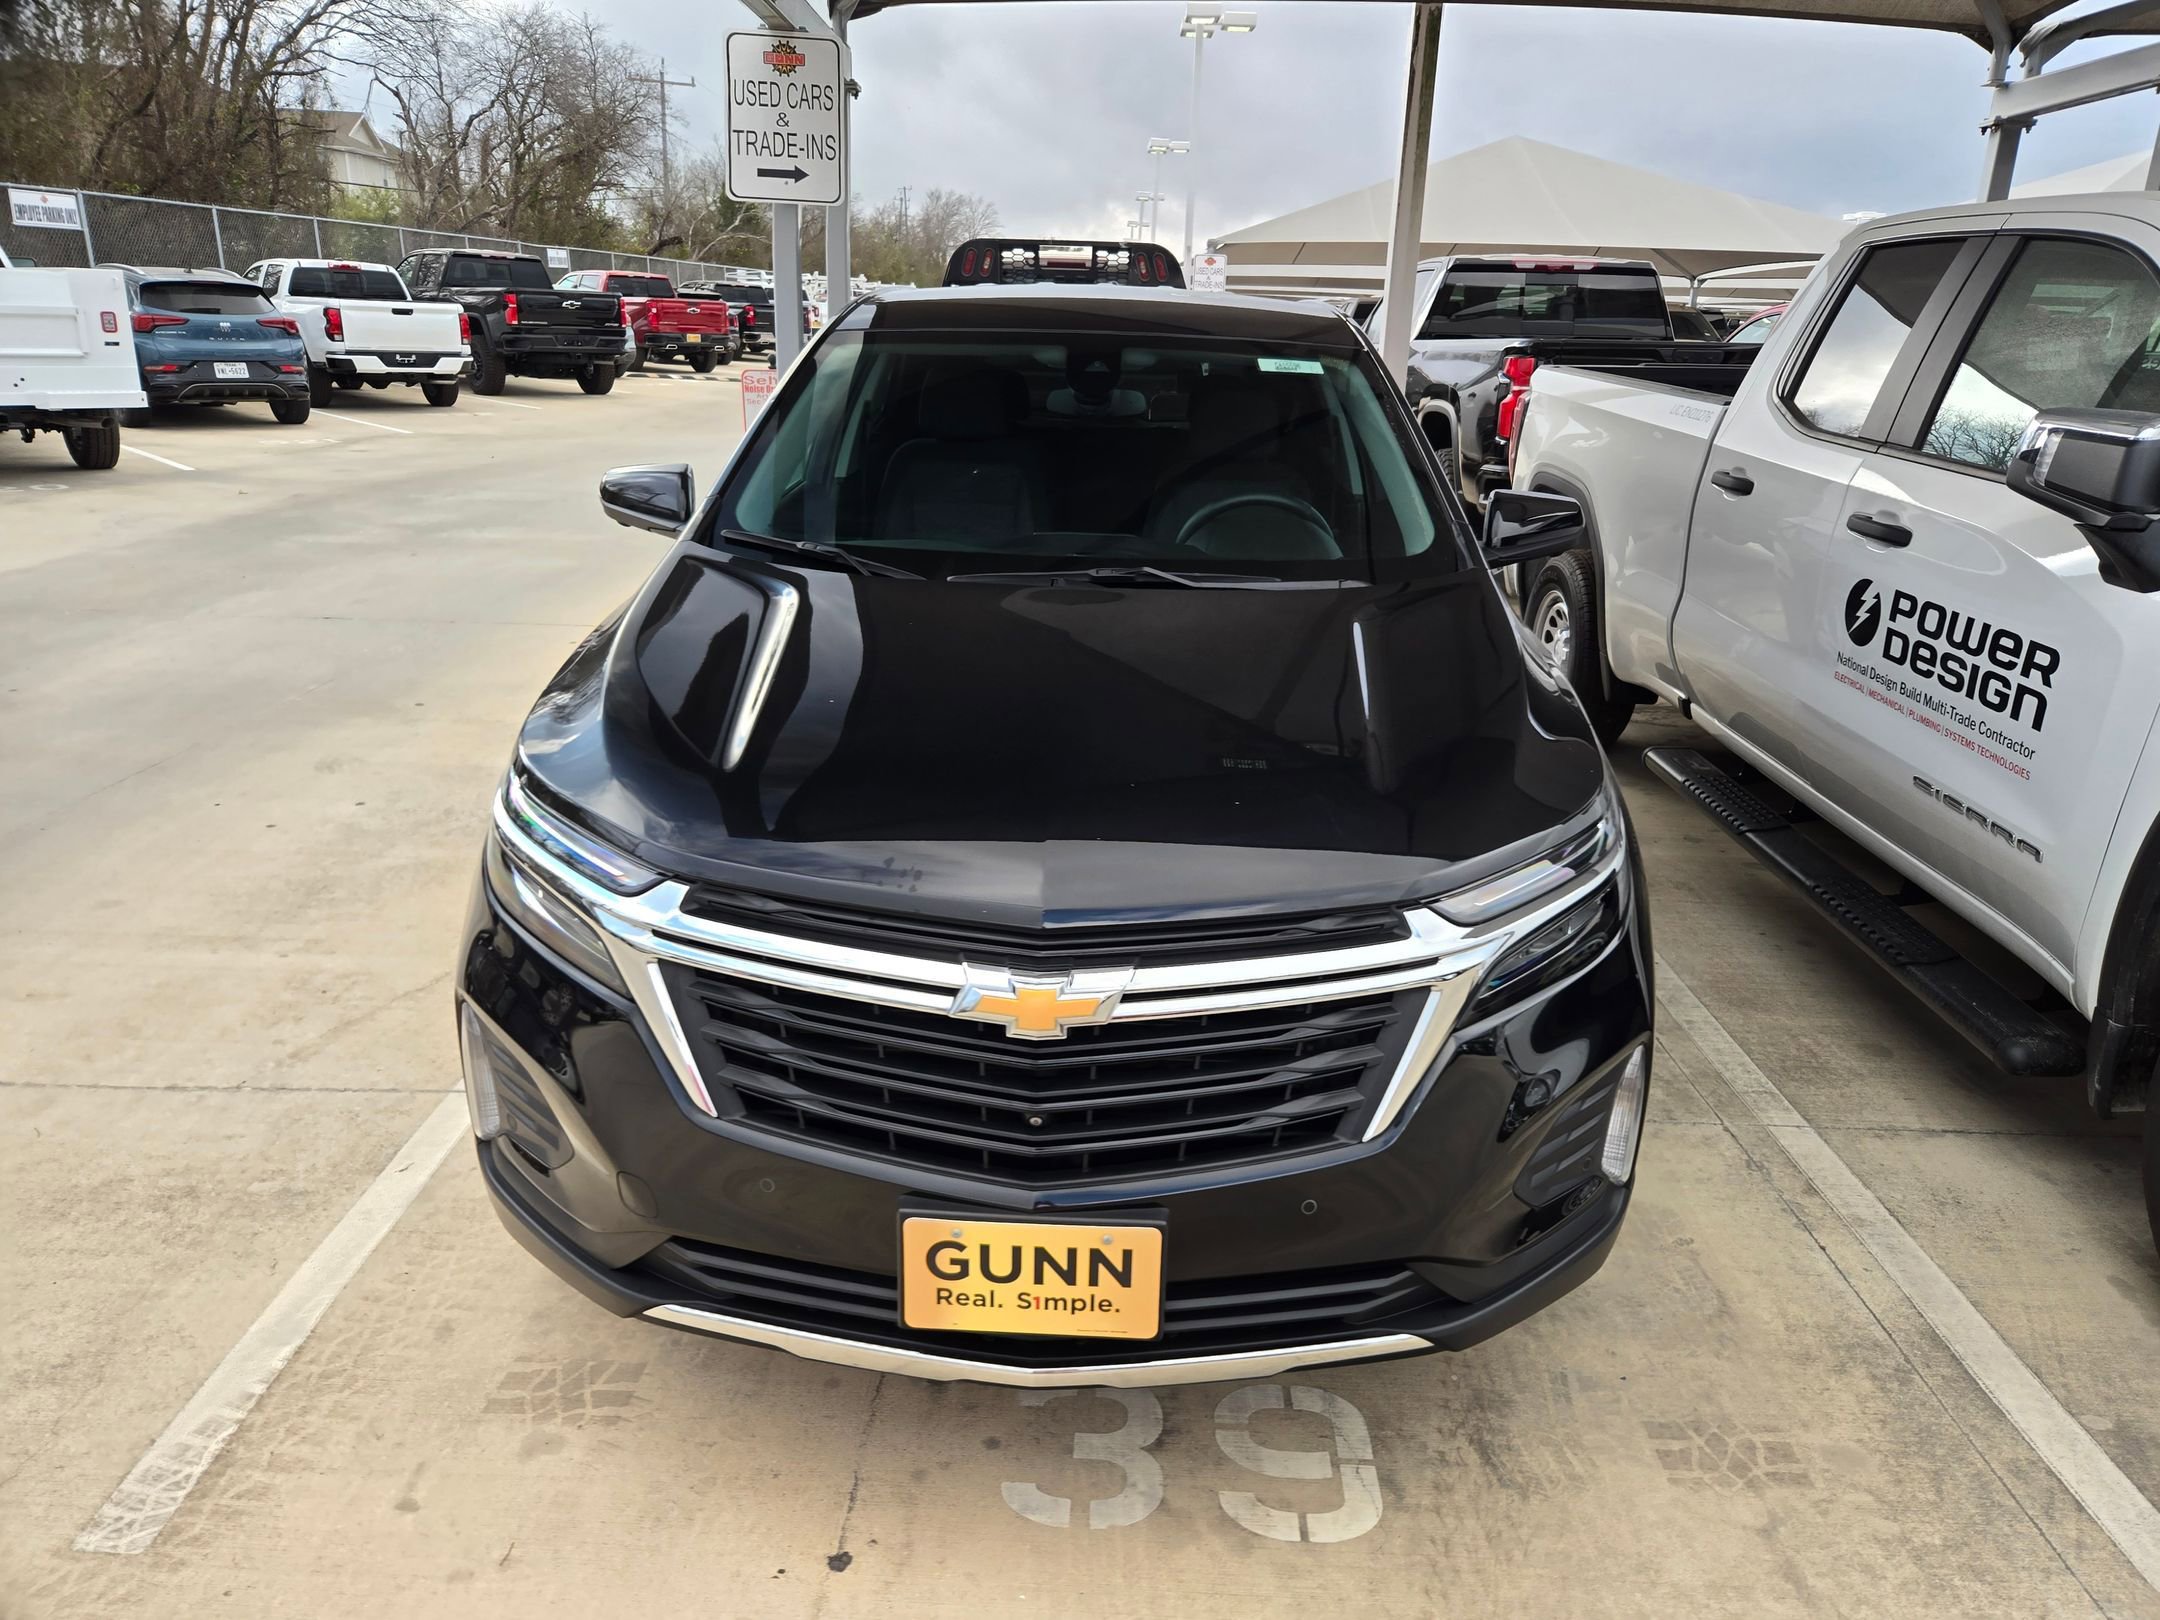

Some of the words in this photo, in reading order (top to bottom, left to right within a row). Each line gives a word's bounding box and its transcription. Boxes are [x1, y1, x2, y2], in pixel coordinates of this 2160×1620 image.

[733, 79, 781, 107] USED
[787, 83, 834, 111] CARS
[776, 112, 790, 127] &
[733, 130, 837, 160] TRADE-INS
[14, 203, 42, 222] EMPLOYEE
[42, 205, 65, 224] PARKING
[65, 208, 78, 225] ONLY
[1837, 651, 1869, 677] National
[1869, 667, 1898, 692] Design
[1900, 682, 1921, 702] Build
[1923, 693, 1977, 731] Multi-Trade
[1978, 721, 2036, 761] Contractor
[1834, 671, 1865, 694] ELECTRICAL
[1868, 688, 1905, 715] MECHANICAL
[1908, 709, 1941, 733] PLUMBING
[1944, 728, 1975, 751] SYSTEMS
[1976, 744, 2031, 781] TECHNOLOGIES
[926, 1240, 1133, 1288] GUNN
[936, 1287, 1003, 1308] Real.
[1017, 1292, 1121, 1315] S1mple.
[1001, 1384, 1383, 1543] 39
